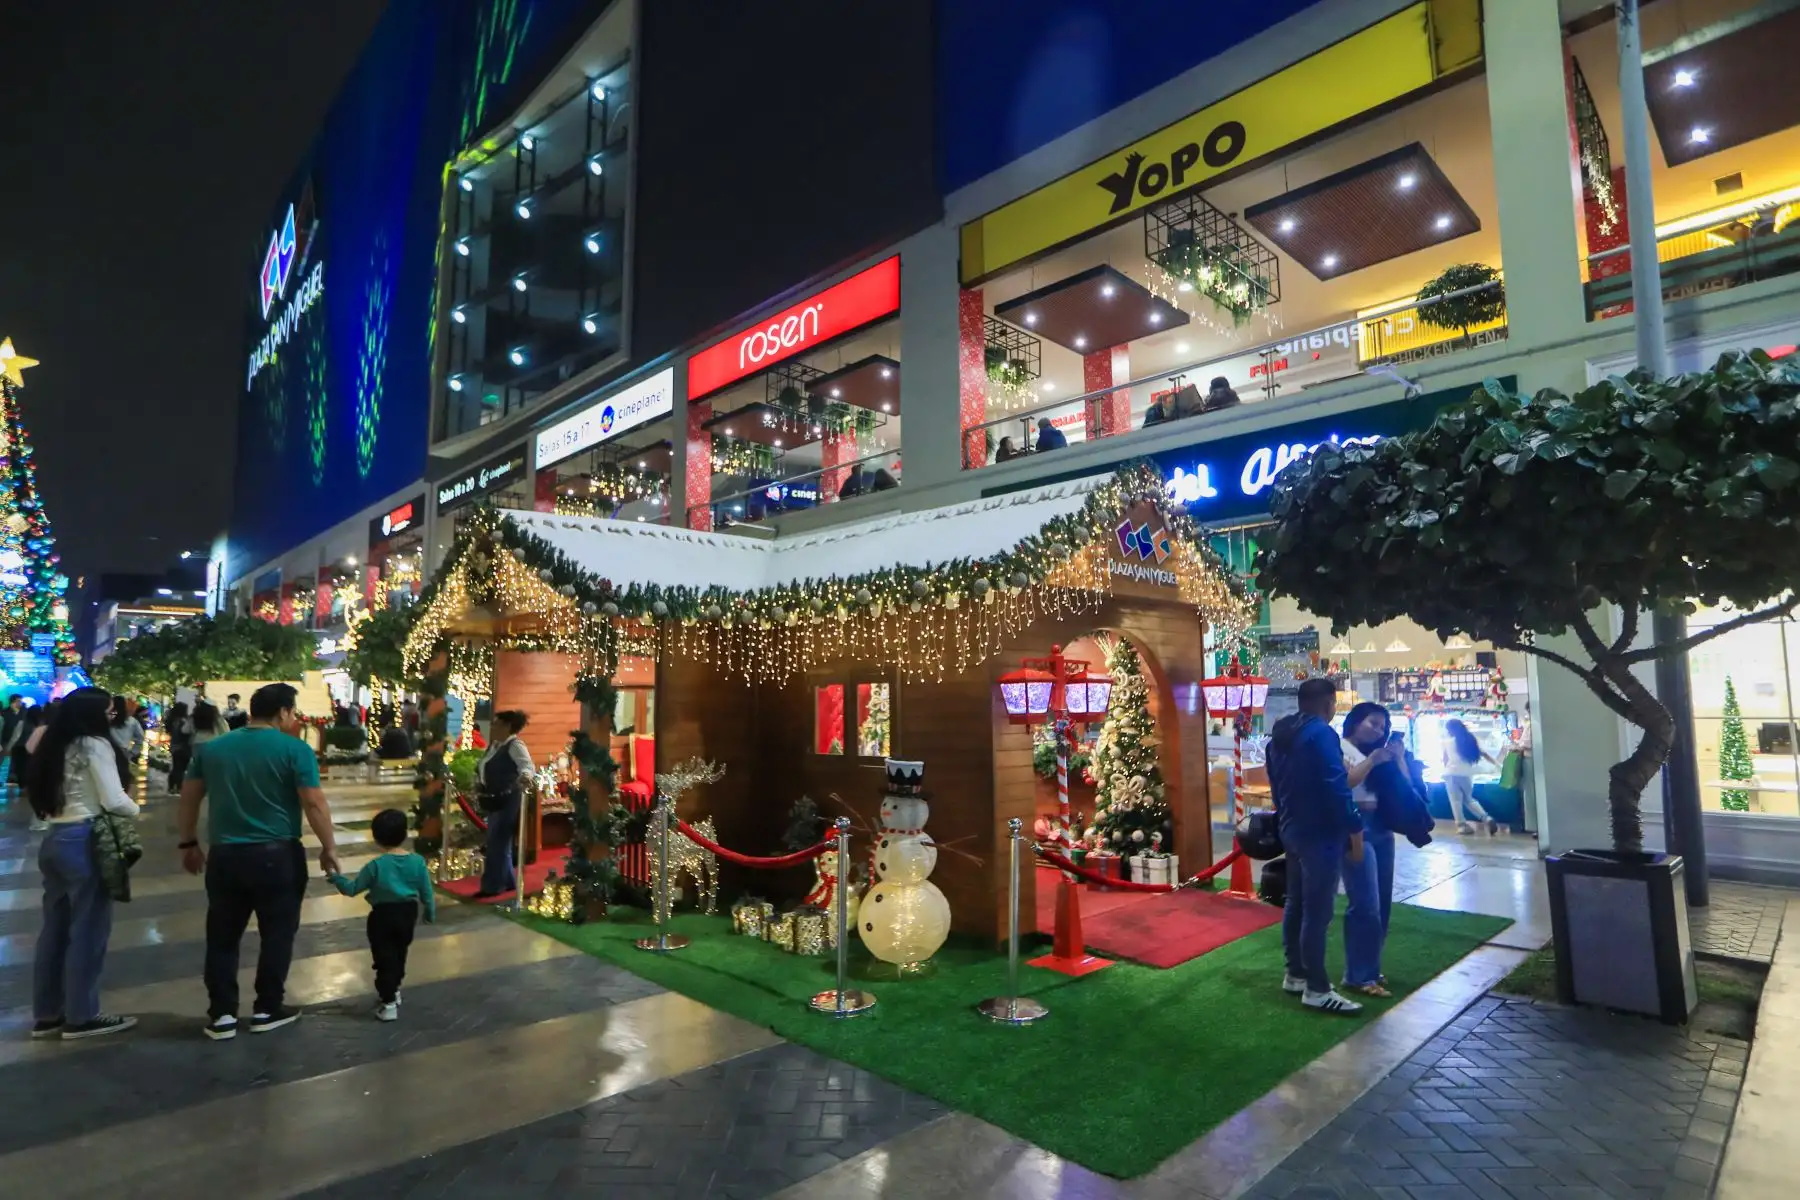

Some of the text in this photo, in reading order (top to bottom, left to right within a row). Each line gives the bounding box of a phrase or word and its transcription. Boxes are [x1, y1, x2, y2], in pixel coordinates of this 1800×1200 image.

[1096, 121, 1246, 215] YOPO
[740, 305, 820, 369] rosen
[563, 430, 573, 446] 15
[618, 387, 667, 420] cineplanet
[465, 476, 475, 492] 20
